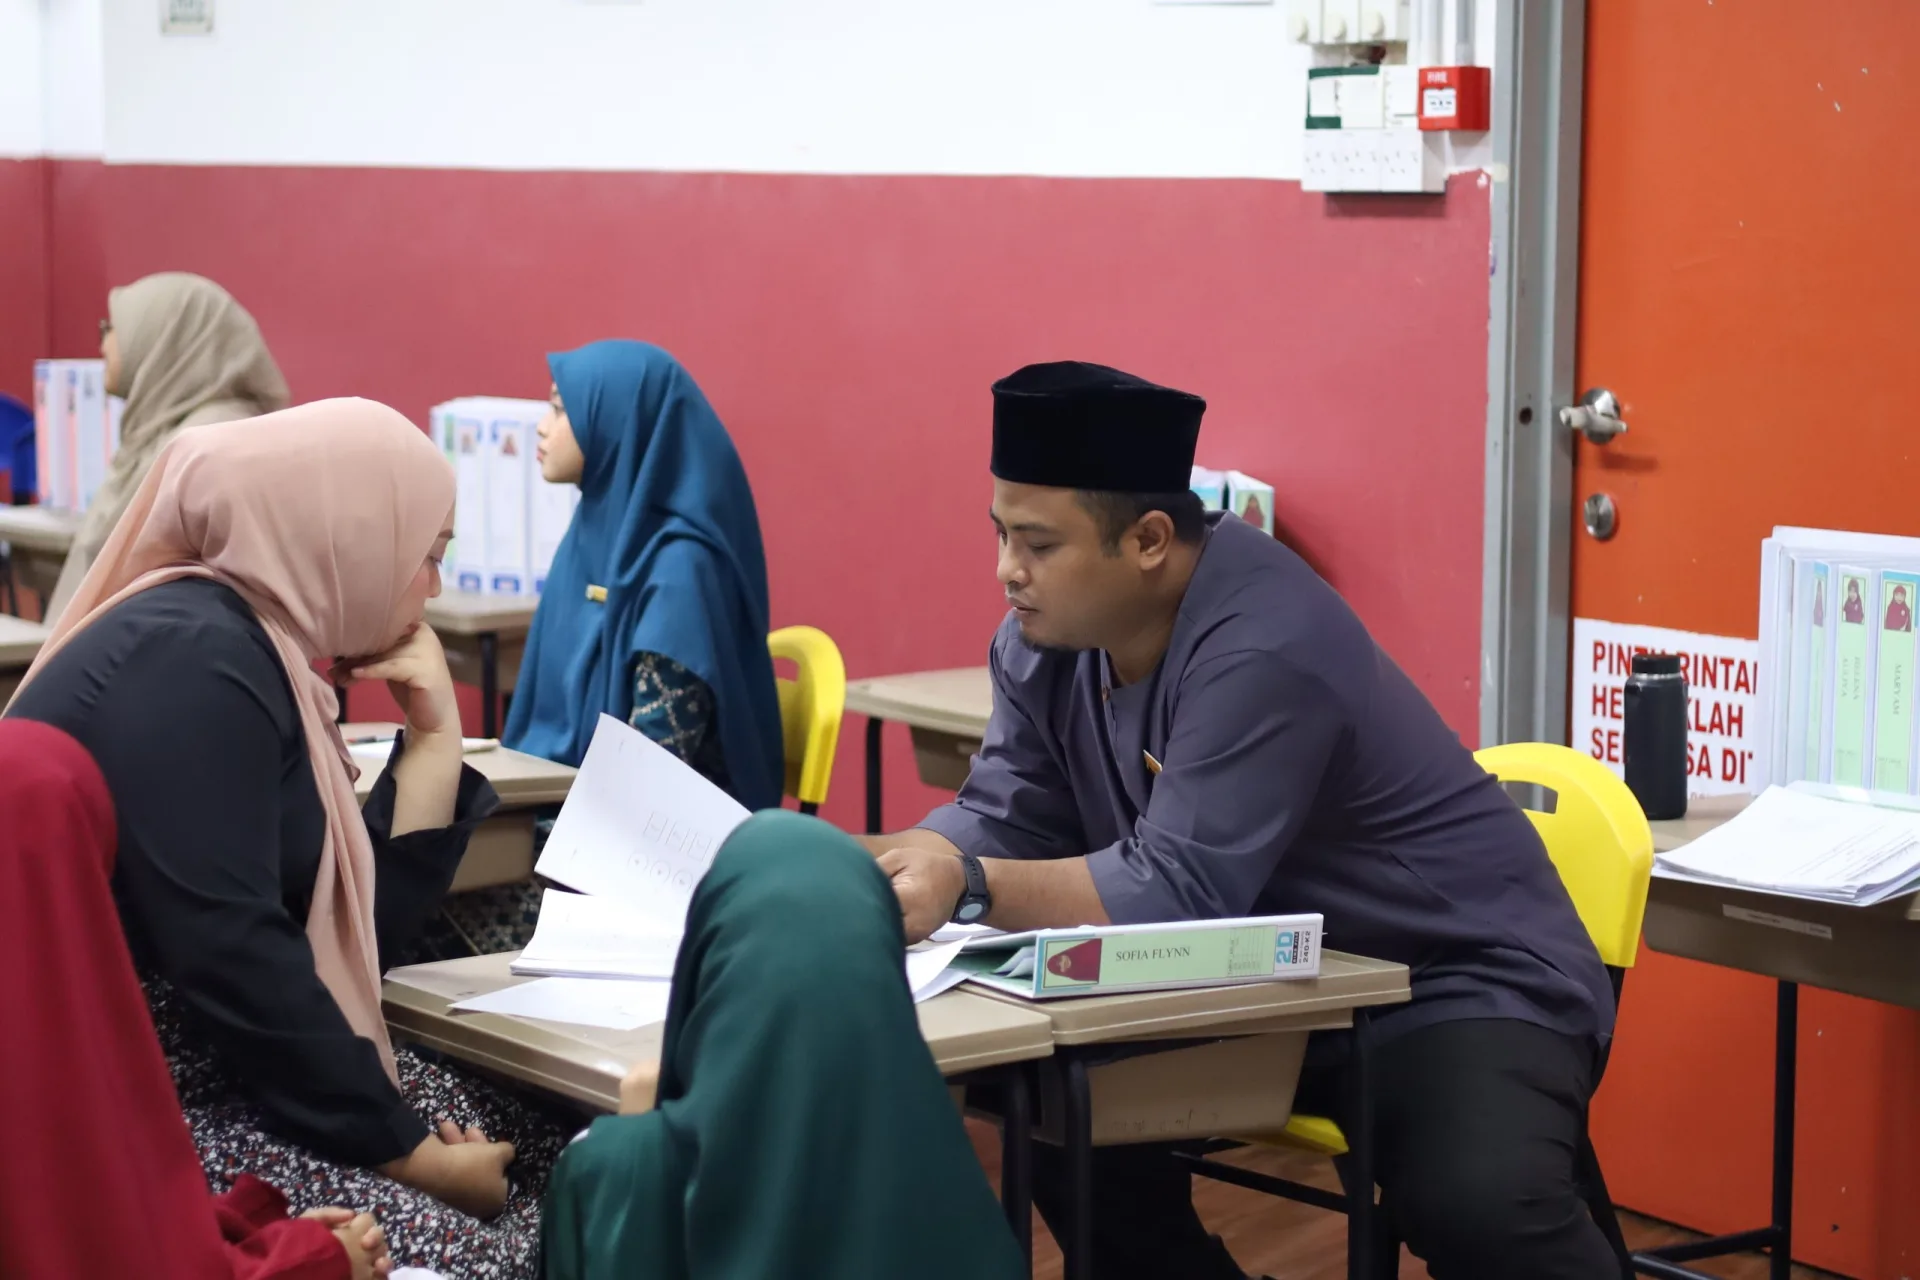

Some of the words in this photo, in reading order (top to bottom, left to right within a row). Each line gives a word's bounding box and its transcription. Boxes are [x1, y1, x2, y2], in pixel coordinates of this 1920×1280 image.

[1893, 664, 1901, 715] MARYAM
[1722, 747, 1753, 784] DI
[1116, 949, 1148, 961] SOFIA
[1152, 946, 1190, 959] FLYNN
[1276, 931, 1294, 964] 2D
